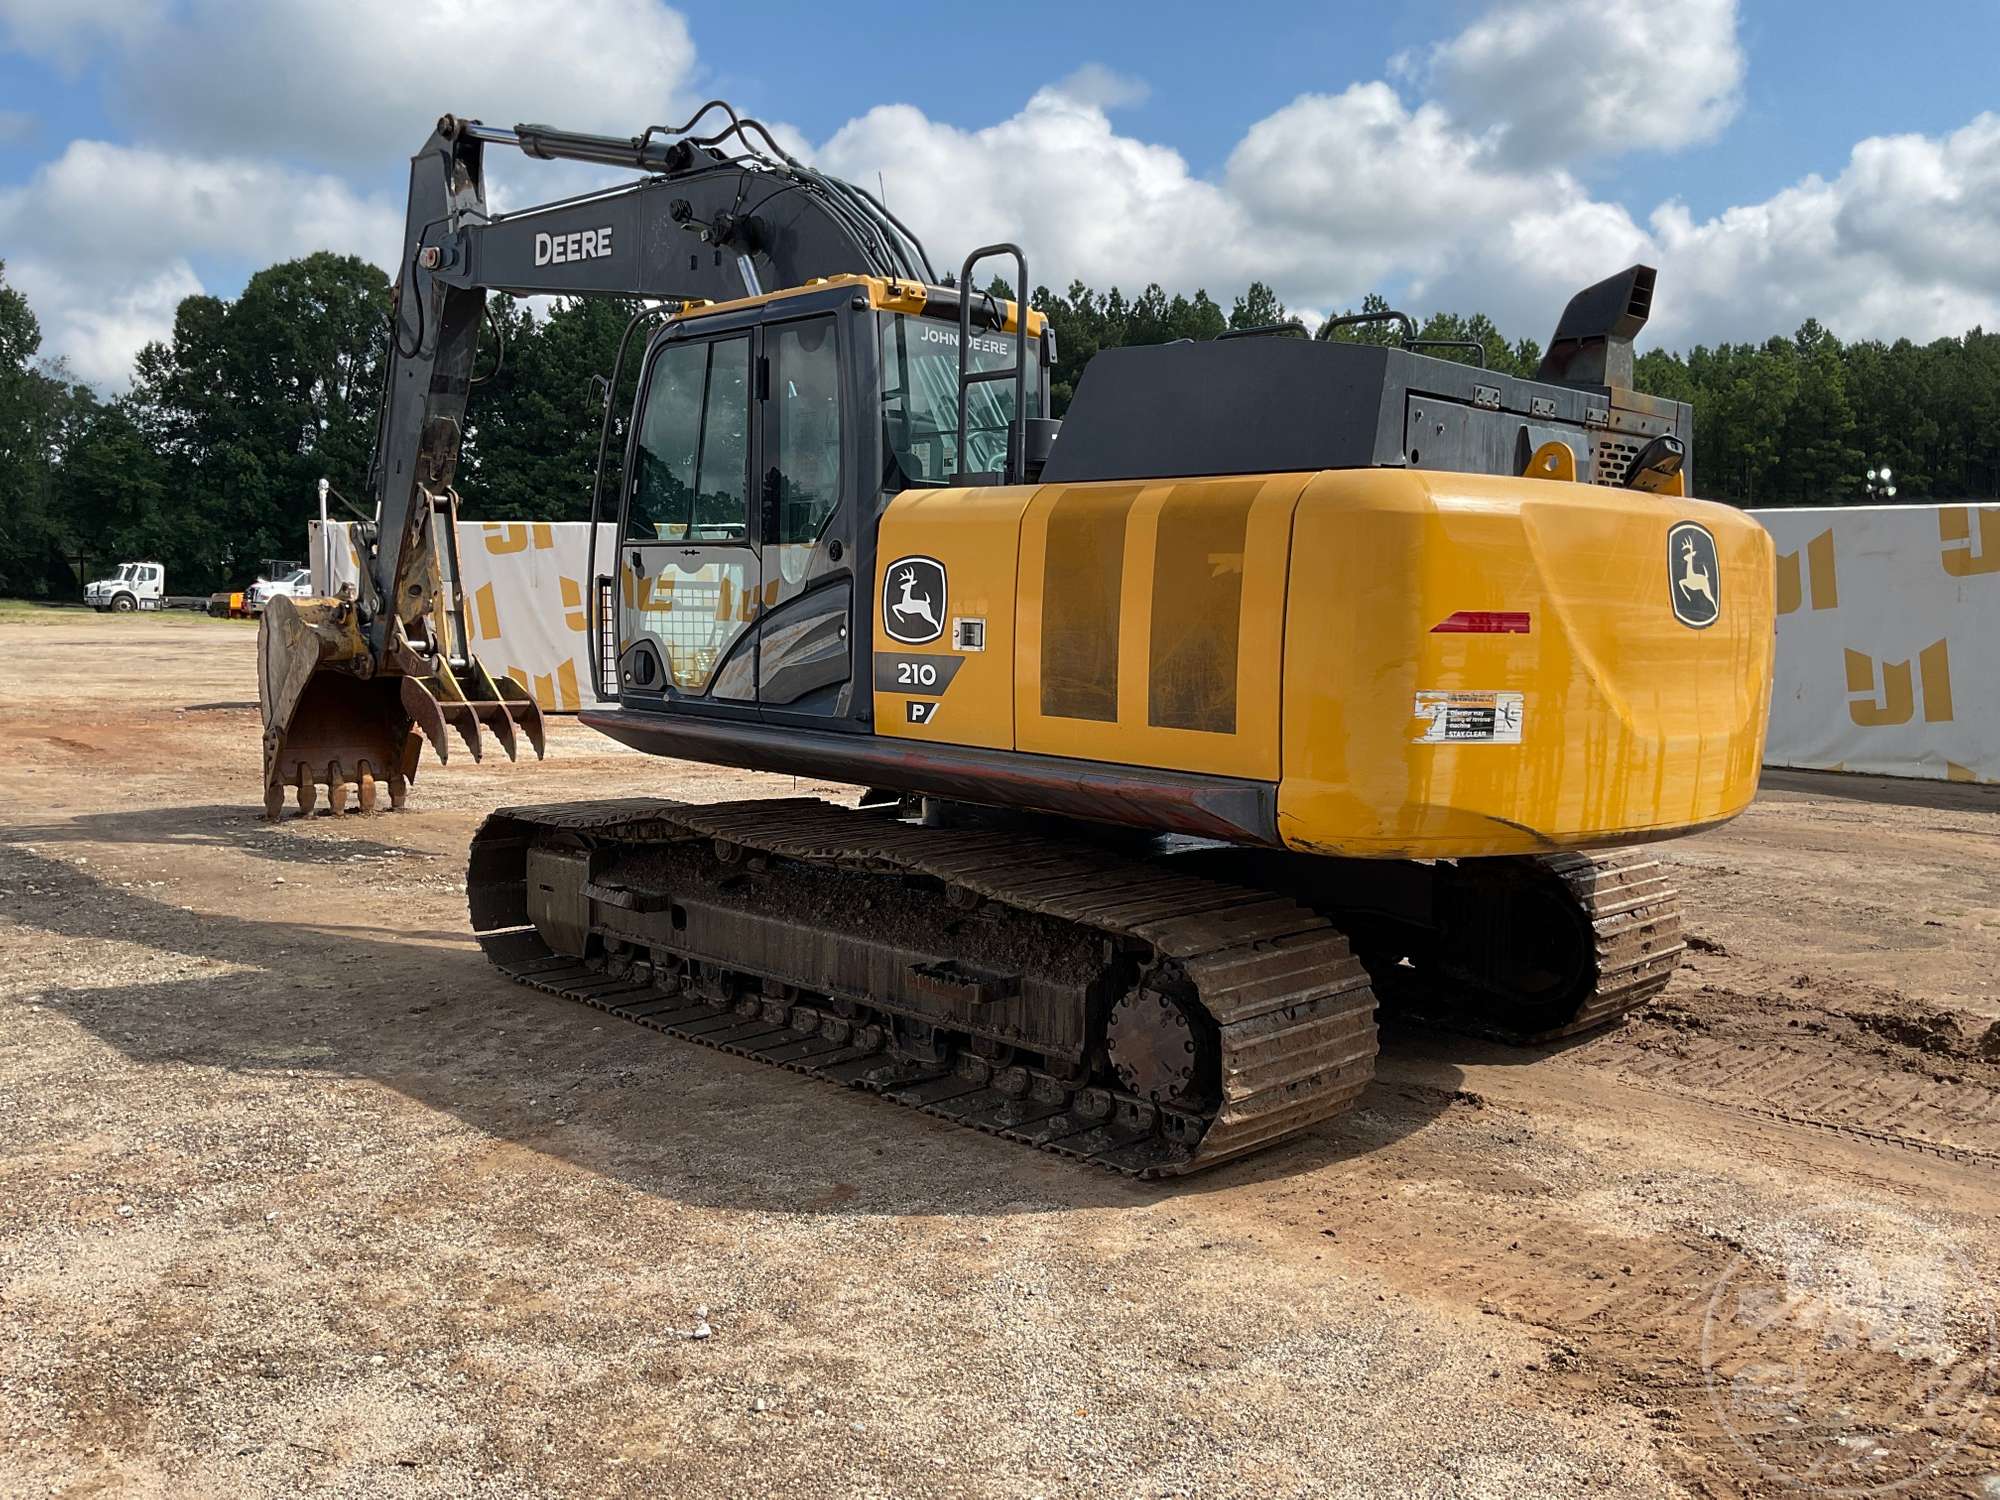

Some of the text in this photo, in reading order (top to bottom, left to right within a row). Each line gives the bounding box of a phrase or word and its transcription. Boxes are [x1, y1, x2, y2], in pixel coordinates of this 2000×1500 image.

[535, 227, 612, 266] DEERE
[920, 326, 959, 346] JOHN
[897, 662, 937, 686] 210
